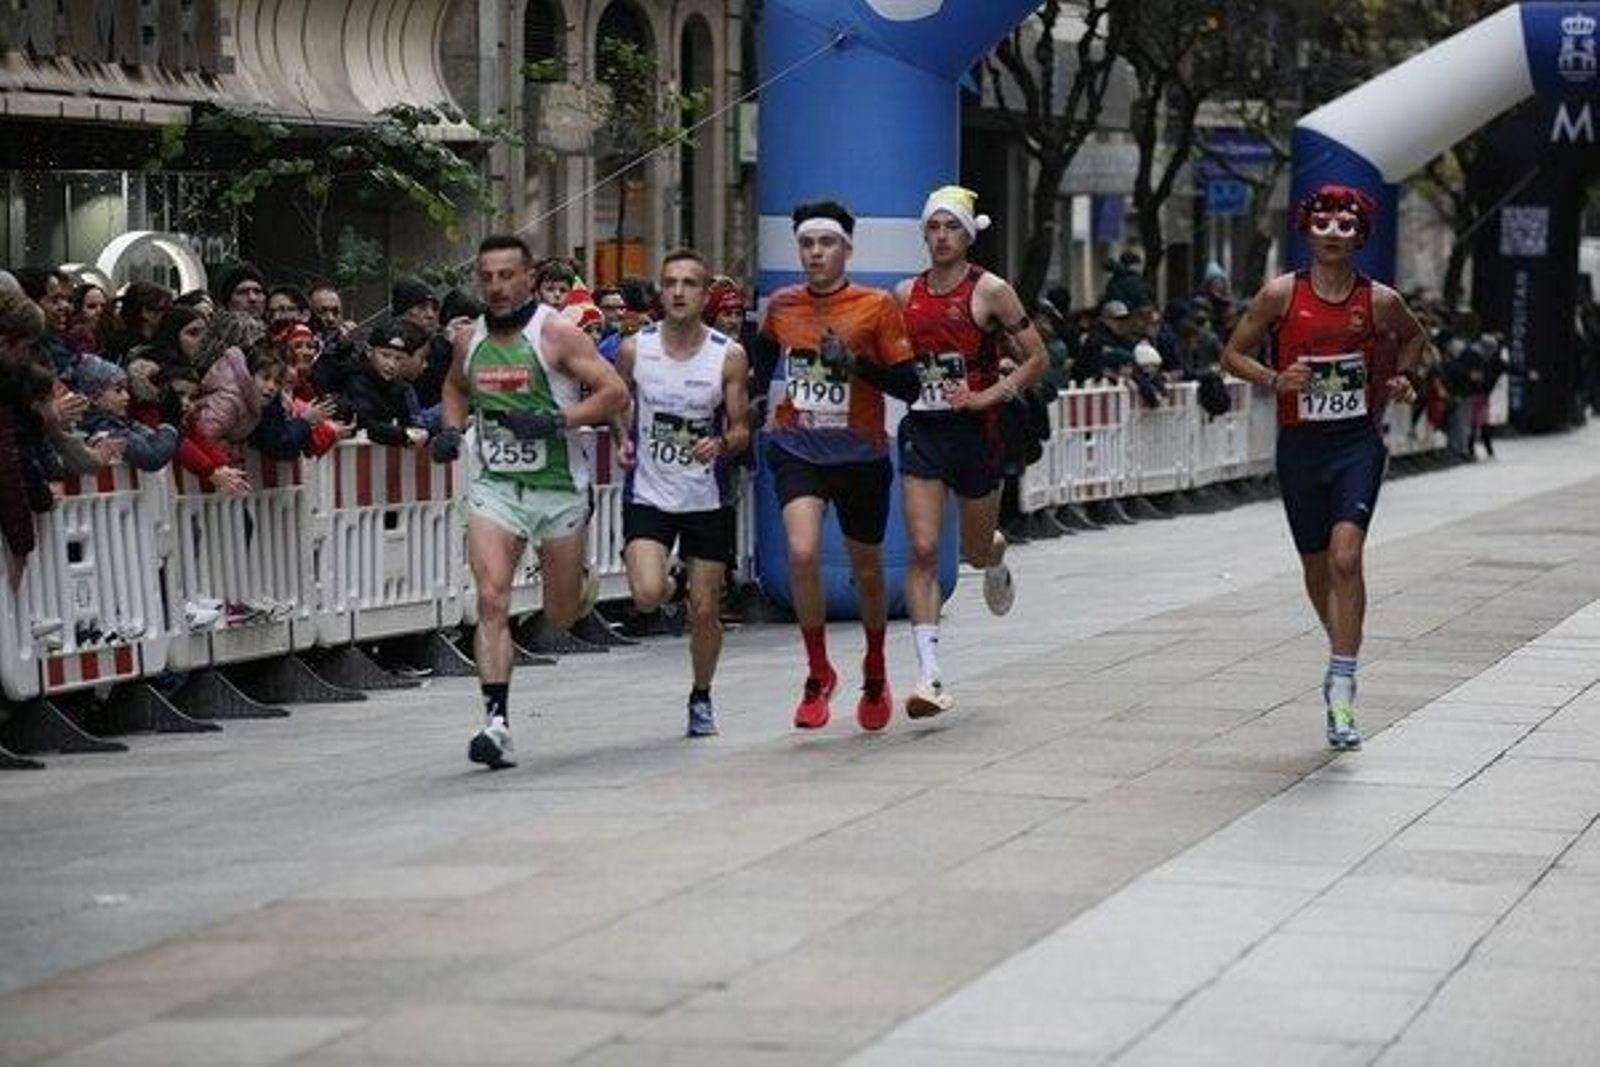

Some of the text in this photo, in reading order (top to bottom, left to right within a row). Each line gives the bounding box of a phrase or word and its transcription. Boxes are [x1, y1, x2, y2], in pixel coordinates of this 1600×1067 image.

[1551, 102, 1594, 142] M
[787, 380, 845, 405] 1190
[1302, 392, 1358, 414] 1786
[489, 440, 538, 464] 255
[649, 441, 697, 467] 105
